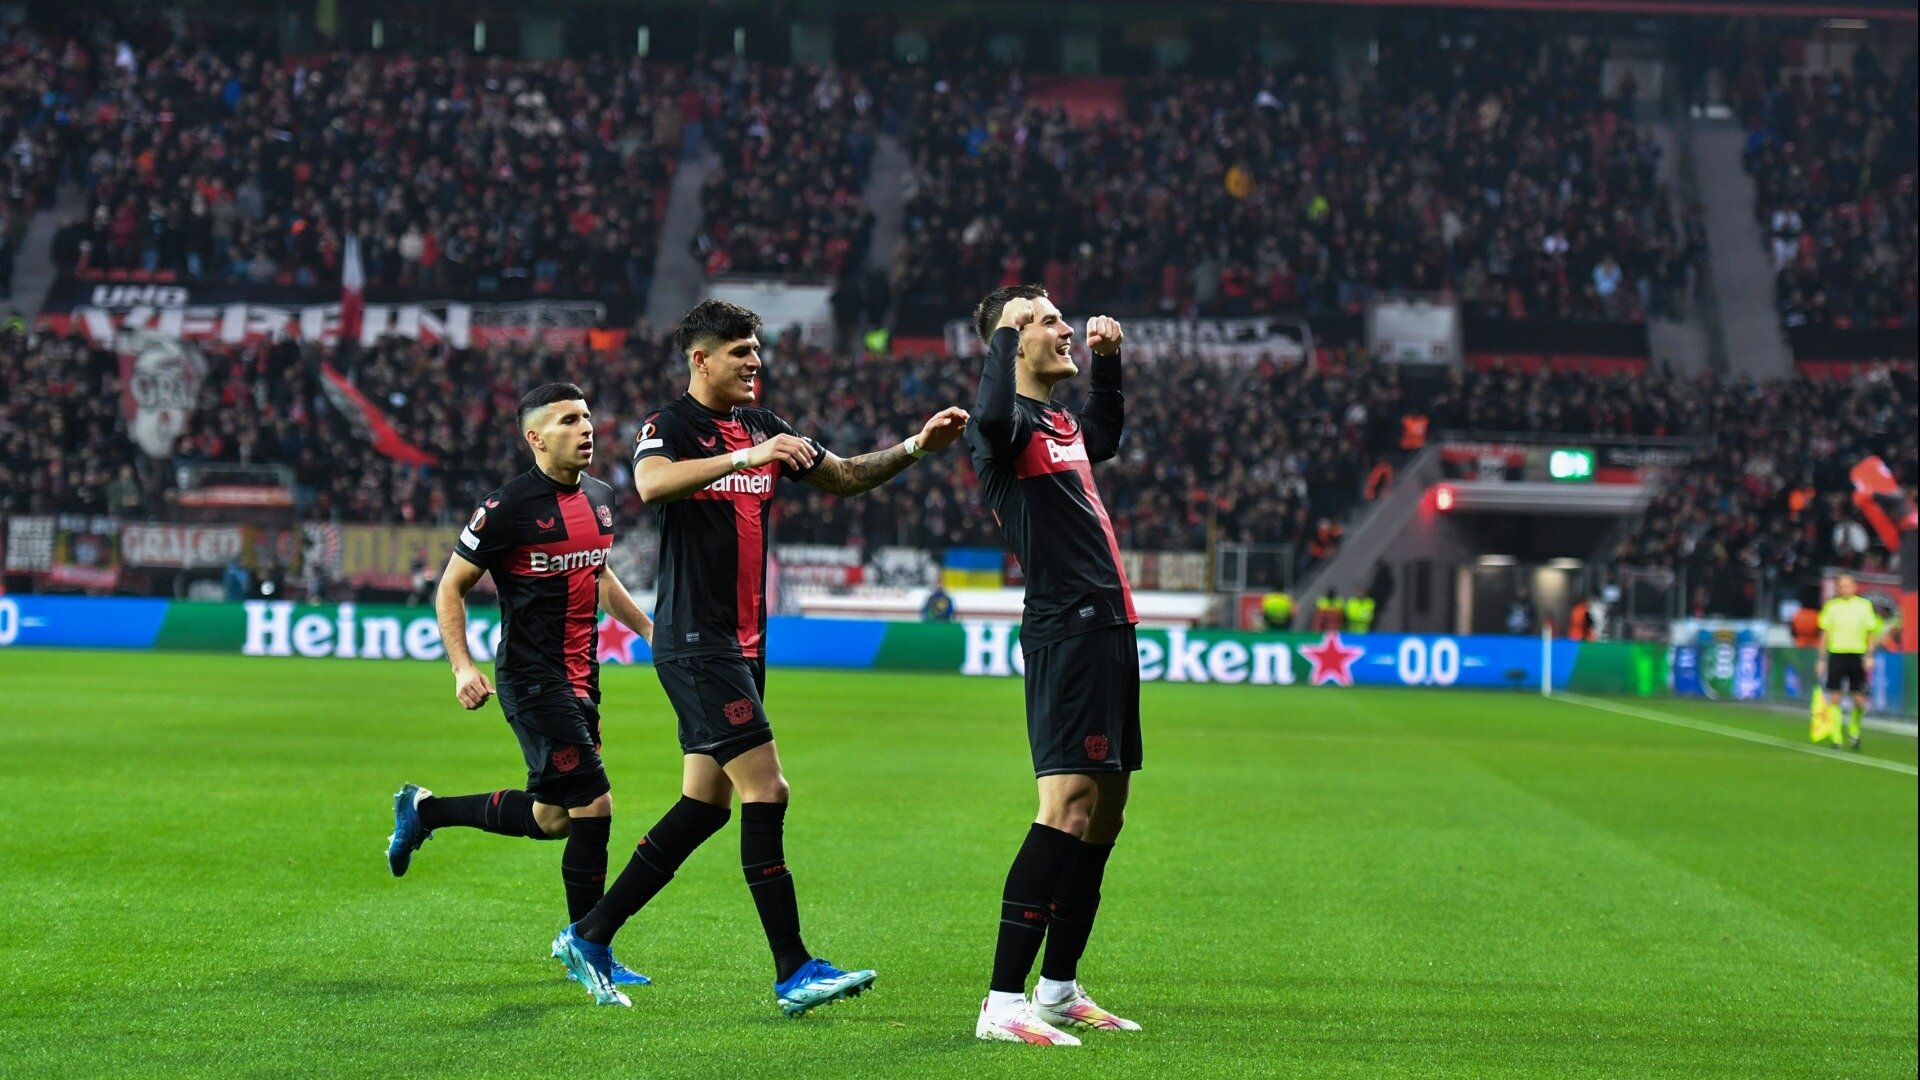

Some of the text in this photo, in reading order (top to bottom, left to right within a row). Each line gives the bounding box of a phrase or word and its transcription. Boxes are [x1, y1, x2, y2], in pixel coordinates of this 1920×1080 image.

[703, 473, 772, 494] armen
[242, 601, 500, 662] Heinek
[1398, 637, 1460, 686] 0.0
